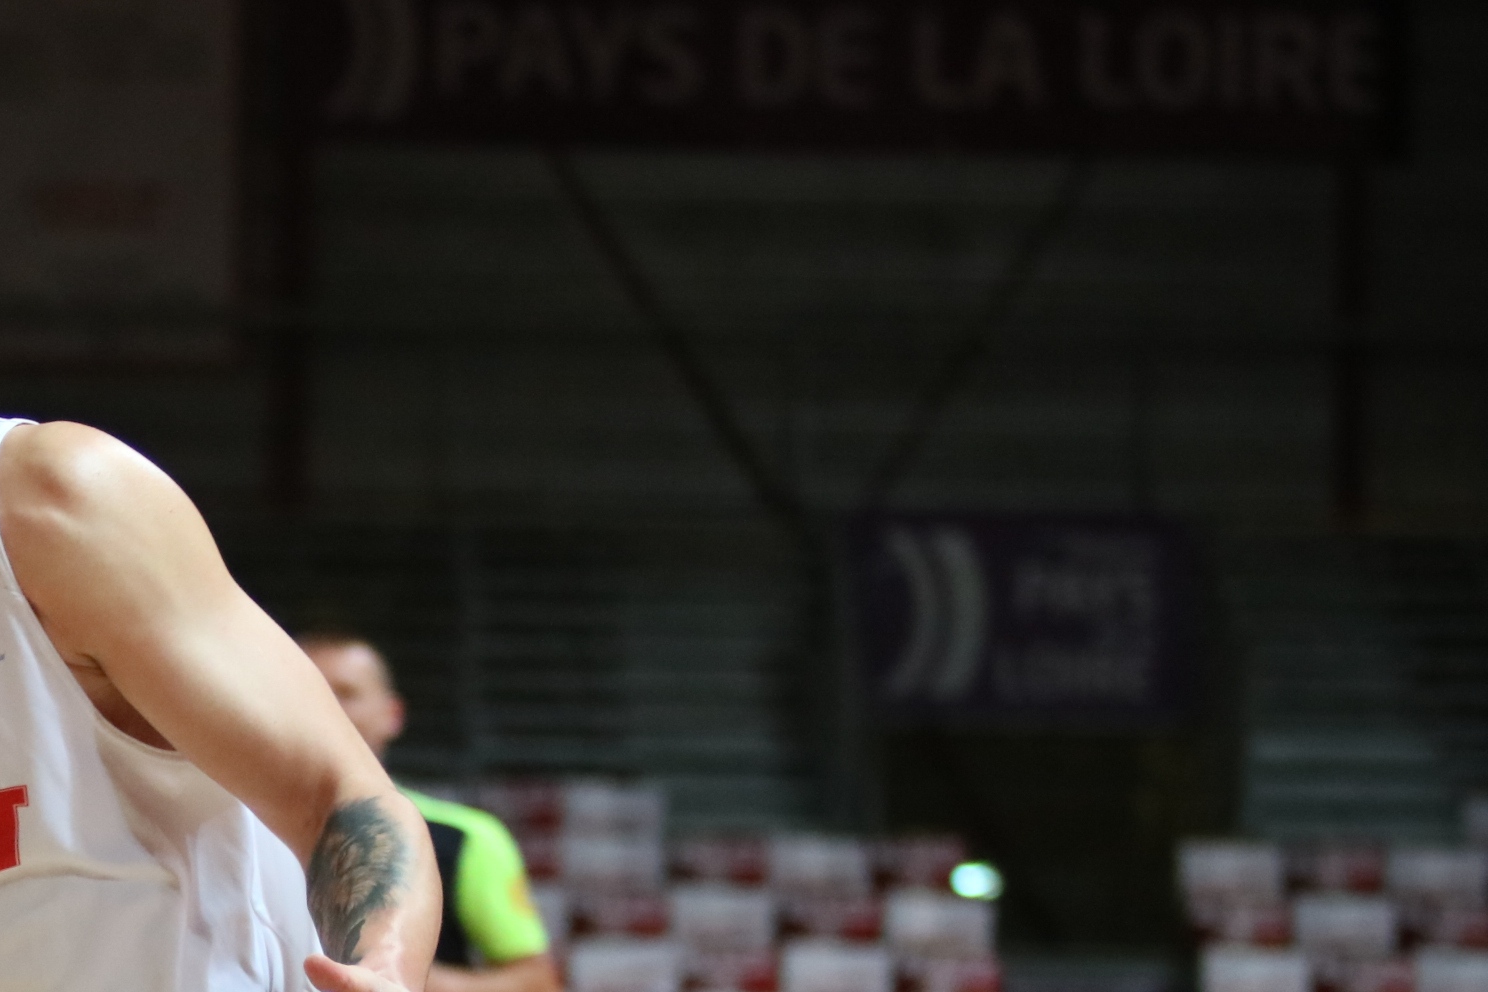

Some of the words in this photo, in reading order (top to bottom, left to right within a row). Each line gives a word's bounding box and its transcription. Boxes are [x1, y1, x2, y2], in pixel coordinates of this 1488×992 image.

[434, 2, 703, 106] PAYS
[735, 5, 881, 109] DE
[911, 6, 1046, 109] LA
[1078, 8, 1378, 114] LOIRE
